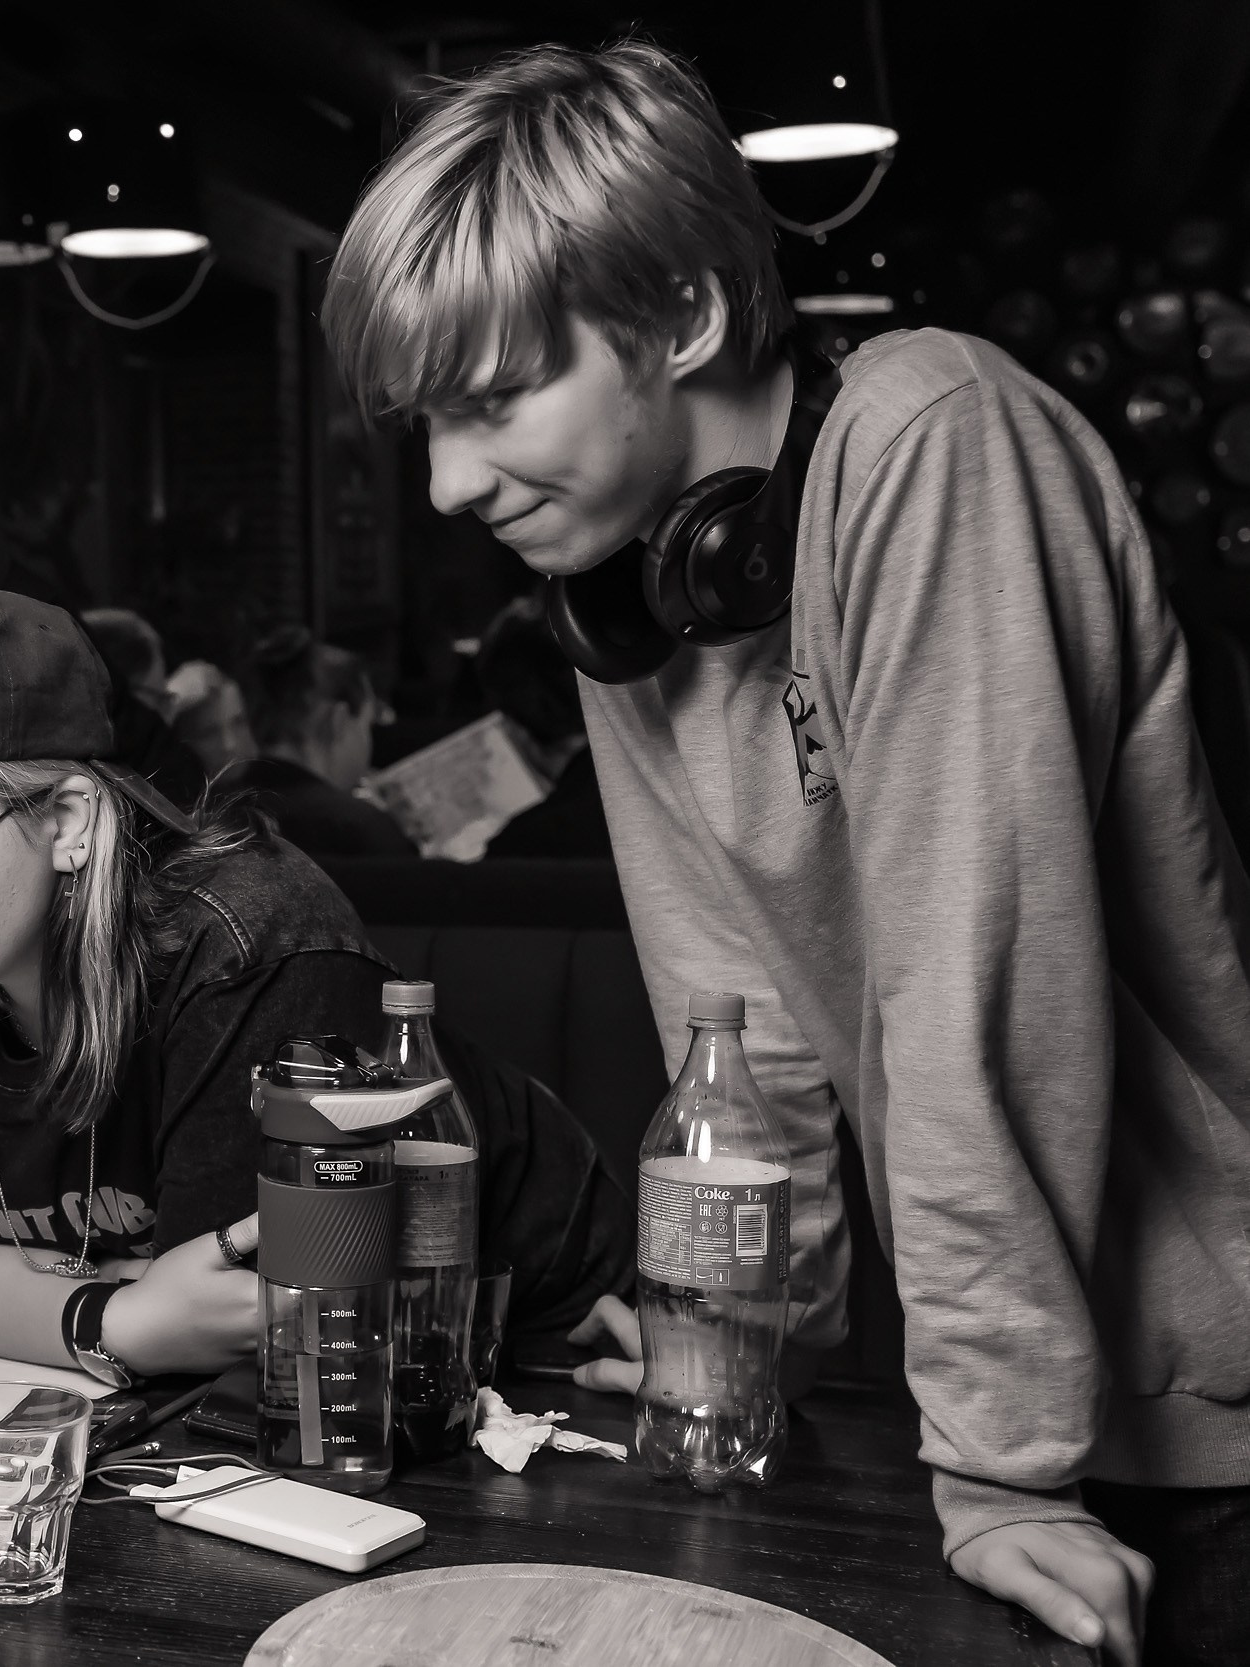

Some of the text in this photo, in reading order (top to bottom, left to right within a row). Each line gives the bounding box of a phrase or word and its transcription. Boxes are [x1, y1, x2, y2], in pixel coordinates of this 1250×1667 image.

[319, 1163, 358, 1171] MAX 800mL
[330, 1173, 357, 1181] 700mL
[694, 1186, 731, 1201] Coke
[331, 1309, 357, 1318] 500mL
[331, 1340, 357, 1350] 400mL
[331, 1372, 357, 1381] 300mL
[331, 1404, 357, 1413] 200mL
[331, 1435, 357, 1444] 100mL
